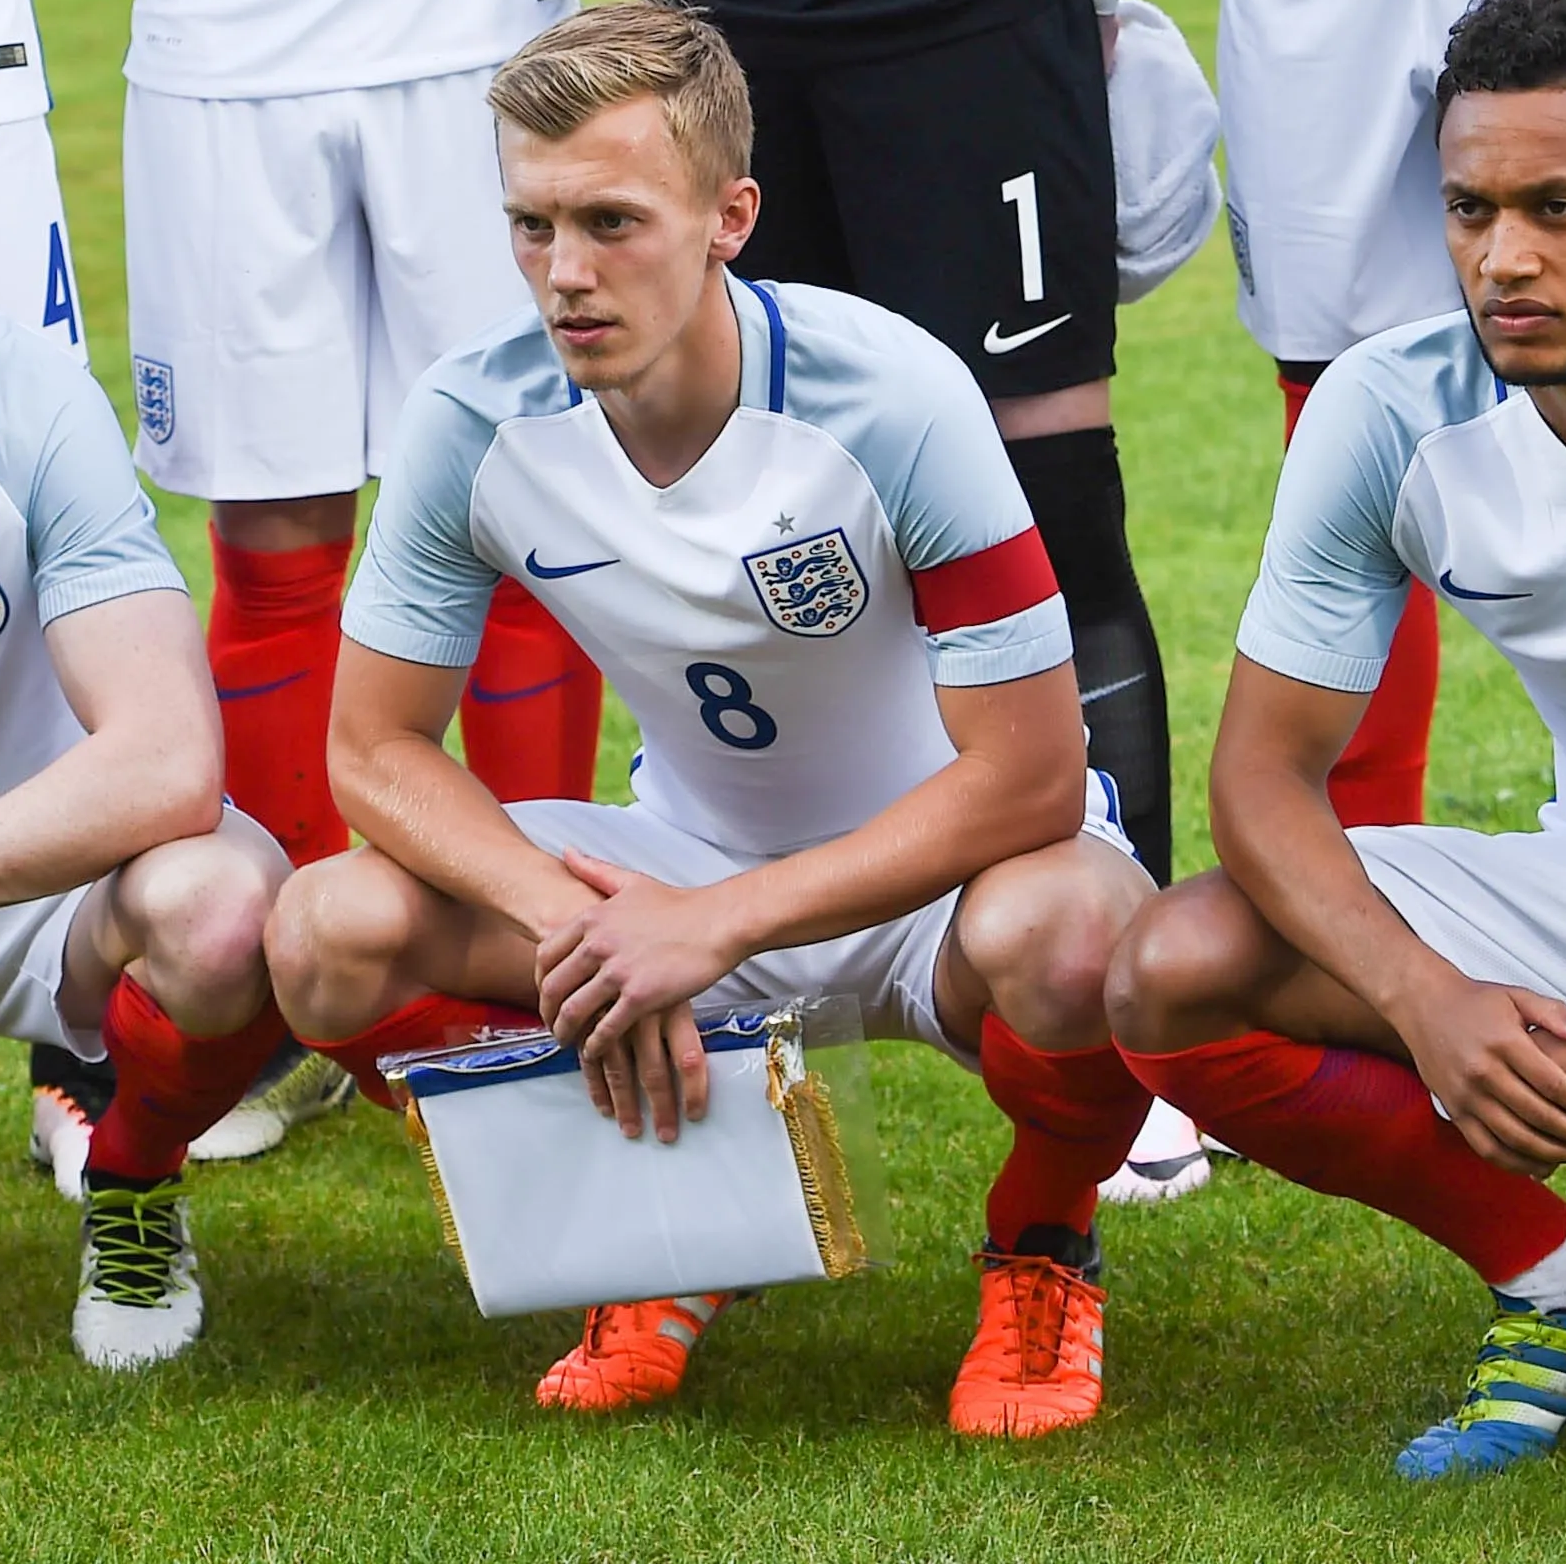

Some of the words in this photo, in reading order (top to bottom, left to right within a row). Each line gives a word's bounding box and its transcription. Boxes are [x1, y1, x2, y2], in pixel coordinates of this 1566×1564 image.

[42, 220, 80, 347] 4
[1000, 170, 1045, 303] 1
[685, 661, 778, 751] 8
